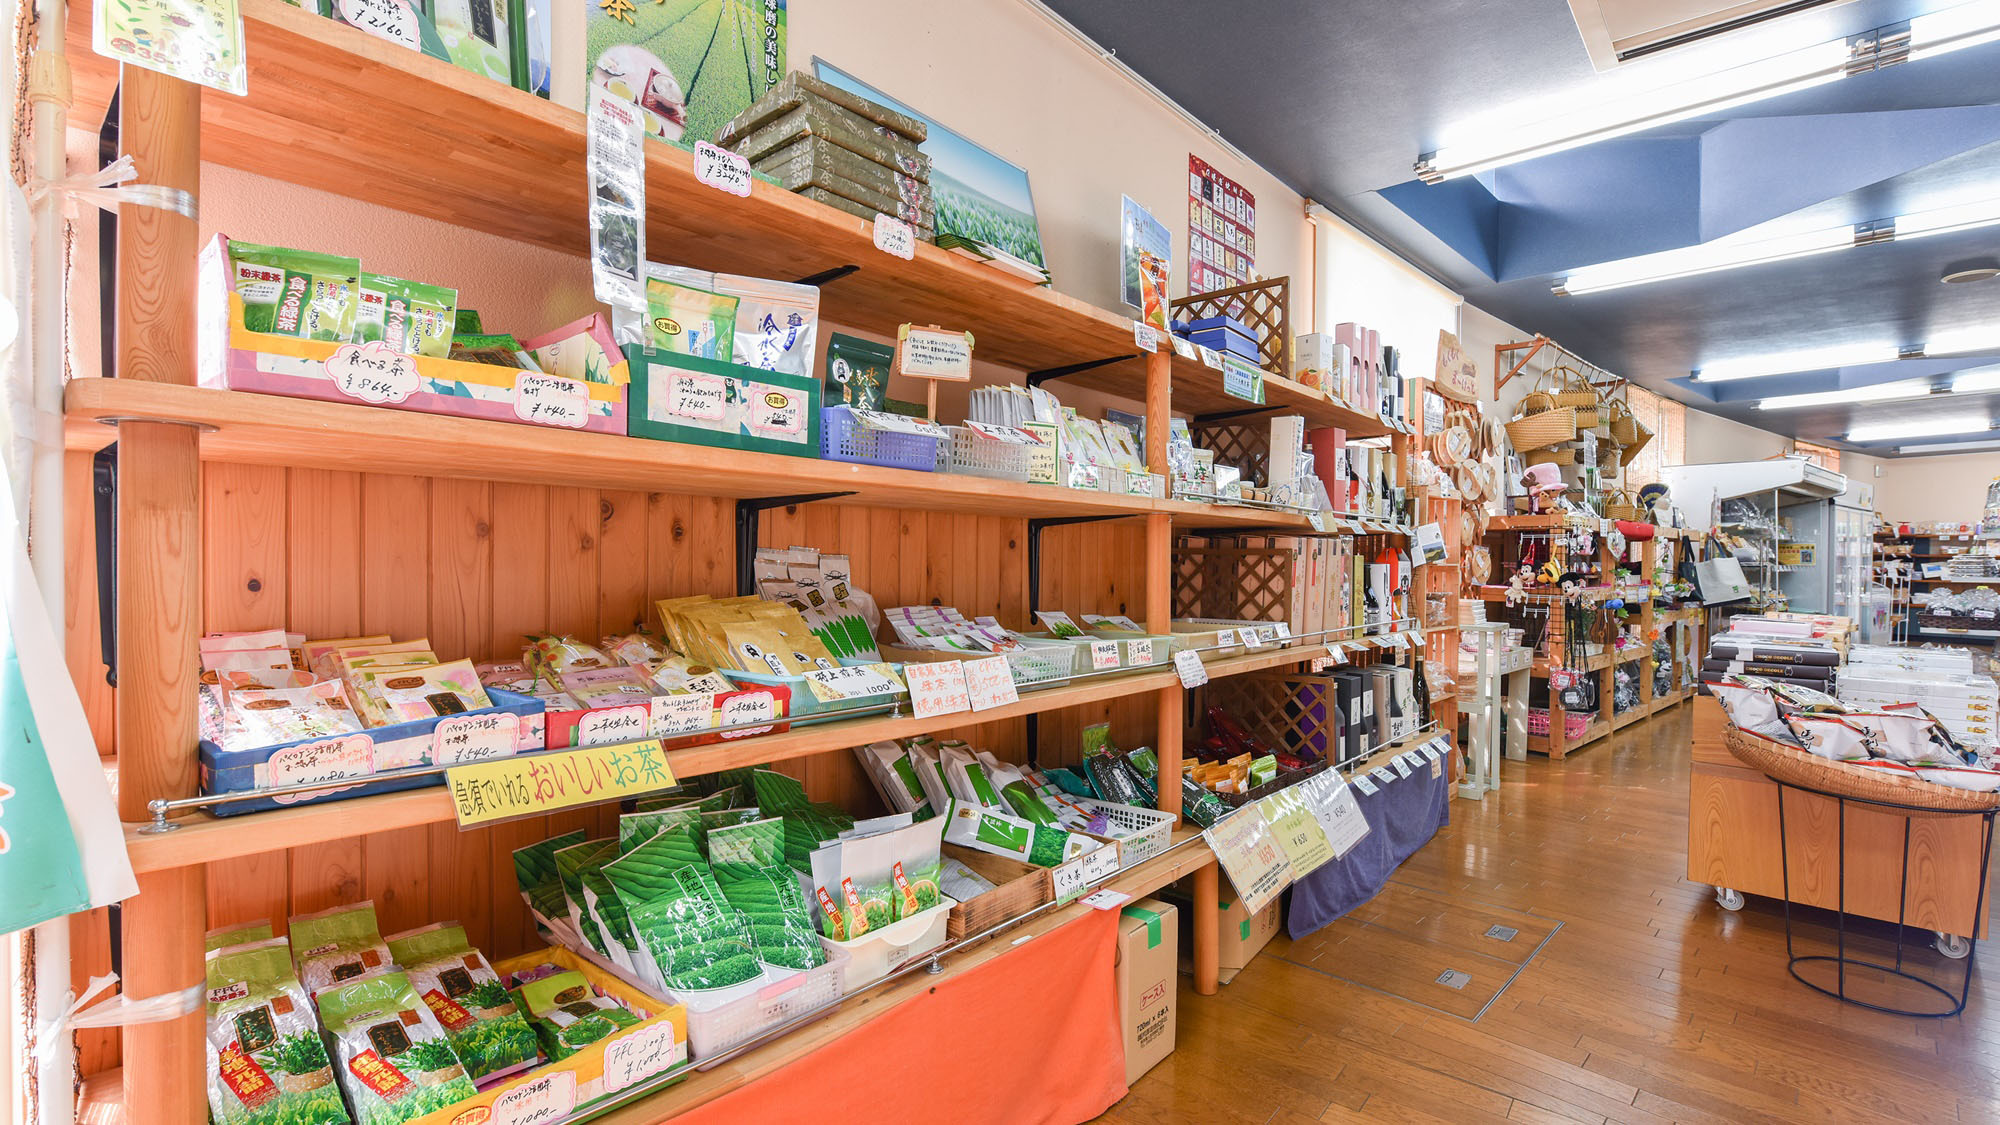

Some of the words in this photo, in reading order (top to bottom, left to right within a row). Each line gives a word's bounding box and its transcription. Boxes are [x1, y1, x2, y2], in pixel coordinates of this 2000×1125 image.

[240, 267, 281, 283] 粉末緑茶
[455, 744, 668, 817] 急須でいれるおいしいお茶
